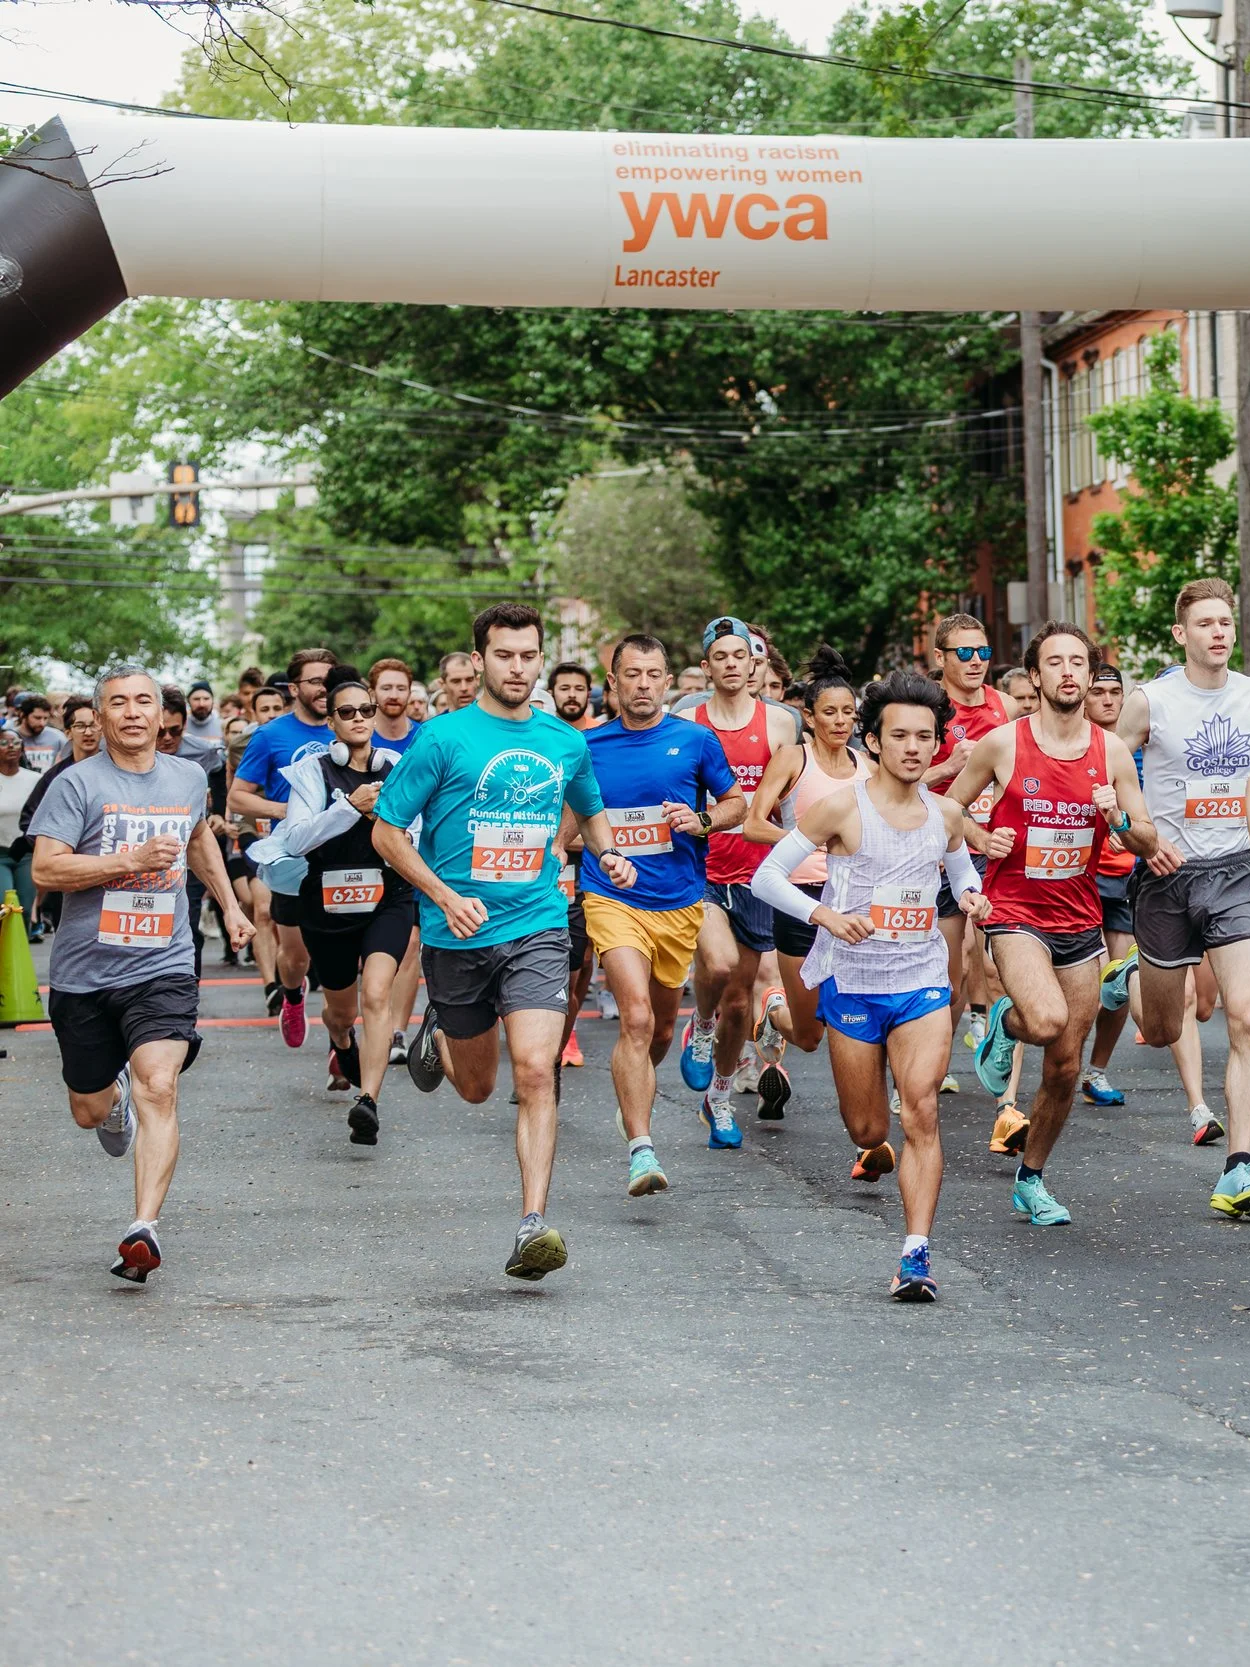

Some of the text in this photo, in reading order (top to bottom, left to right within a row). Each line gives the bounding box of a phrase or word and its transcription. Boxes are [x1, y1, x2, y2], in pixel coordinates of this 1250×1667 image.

[613, 141, 839, 161] eliminating racism
[616, 165, 862, 185] empowering women
[619, 191, 828, 253] ywca
[614, 264, 720, 288] Lancaster
[1187, 754, 1250, 769] Goshen
[1203, 766, 1235, 776] College
[469, 808, 557, 823] Running Within My
[1022, 799, 1097, 817] RED ROSE
[1194, 800, 1242, 816] 6268
[1031, 814, 1088, 826] Track Club
[102, 814, 117, 857] wca
[615, 826, 659, 845] 6101
[481, 850, 537, 869] 2457
[1040, 849, 1081, 867] 702
[332, 887, 377, 903] 6237
[118, 914, 160, 934] 1141
[883, 909, 928, 928] 1652
